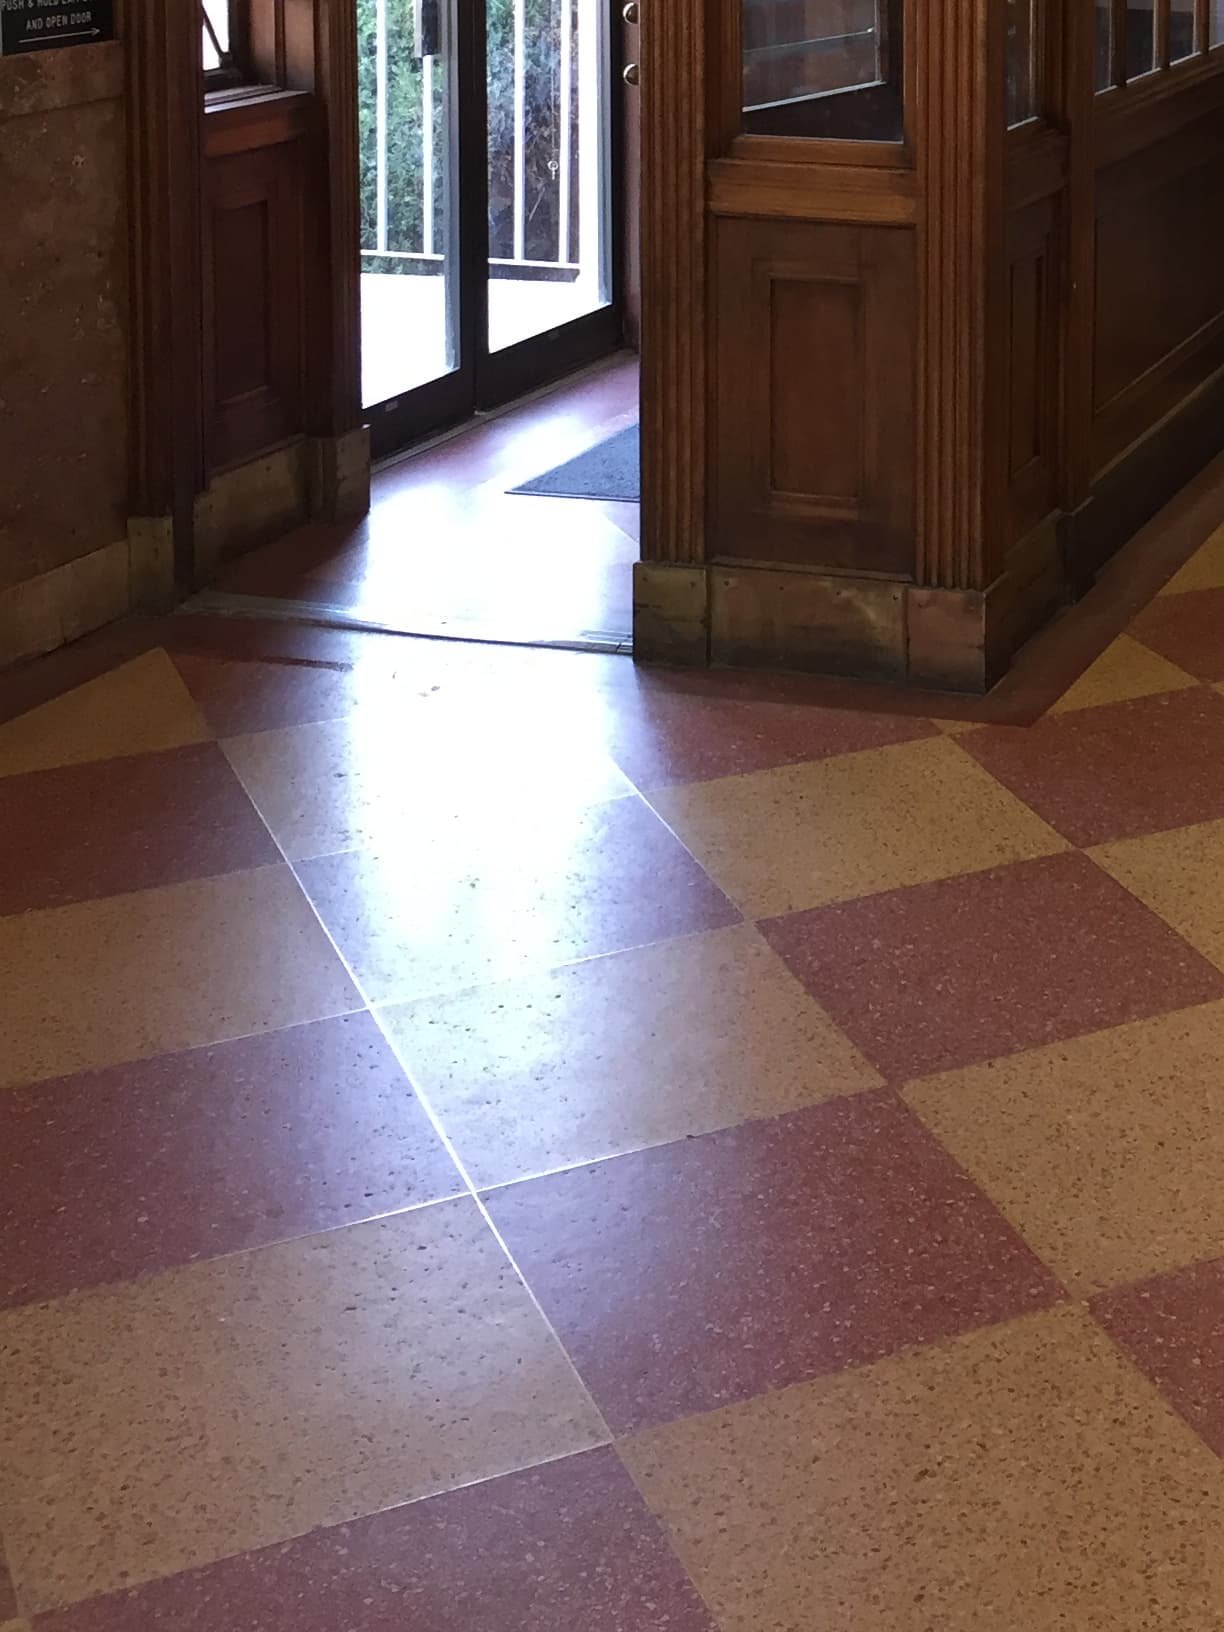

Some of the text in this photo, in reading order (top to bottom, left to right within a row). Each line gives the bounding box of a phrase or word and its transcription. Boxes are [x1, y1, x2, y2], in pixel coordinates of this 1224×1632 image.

[0, 0, 24, 11] PUSH
[26, 11, 92, 31] AND OPEN DOOR
